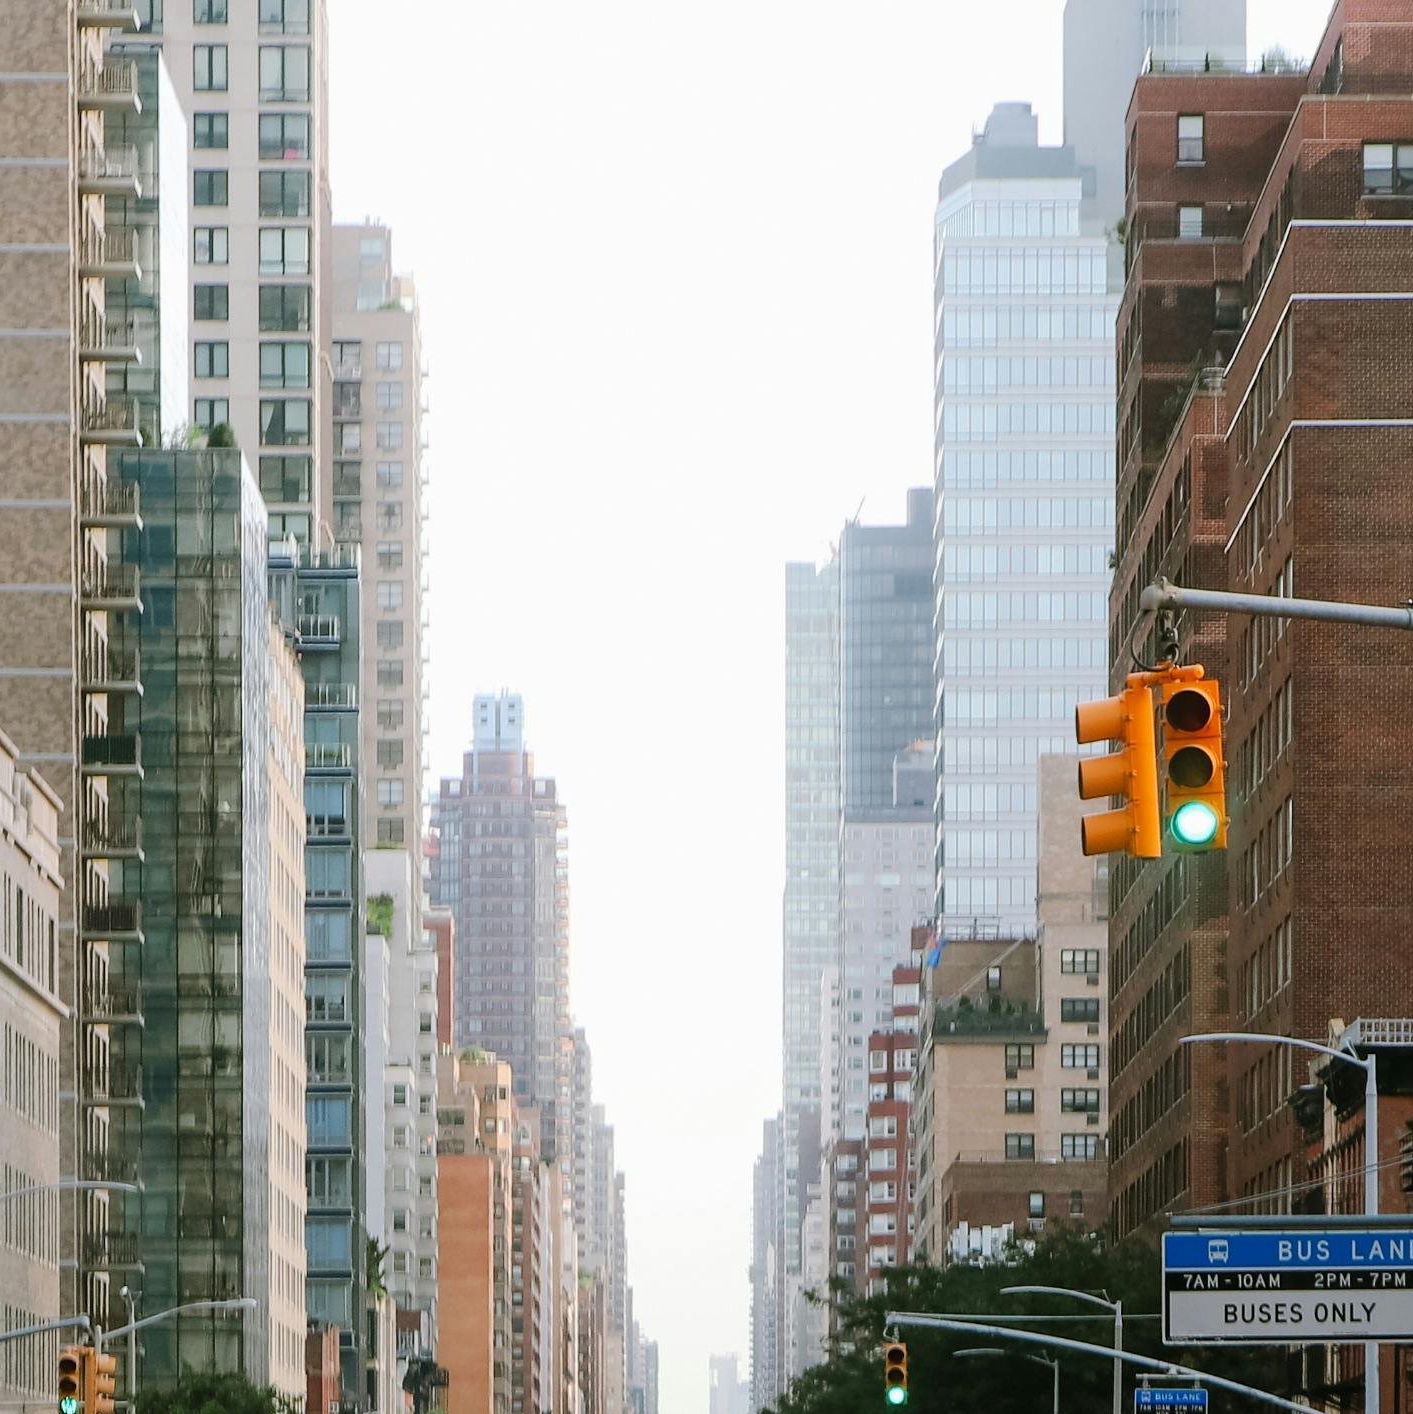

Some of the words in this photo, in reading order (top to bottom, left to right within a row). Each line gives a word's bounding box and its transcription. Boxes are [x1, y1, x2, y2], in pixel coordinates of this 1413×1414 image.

[1279, 1239, 1331, 1261] BUS
[1183, 1273, 1219, 1289] 7AM
[1237, 1273, 1281, 1288] 10AM
[1314, 1272, 1350, 1288] 2PM
[1370, 1272, 1406, 1287] 7PM
[1224, 1303, 1303, 1324] BUSES
[1314, 1302, 1377, 1323] ONLY
[1176, 1392, 1201, 1400] LANE
